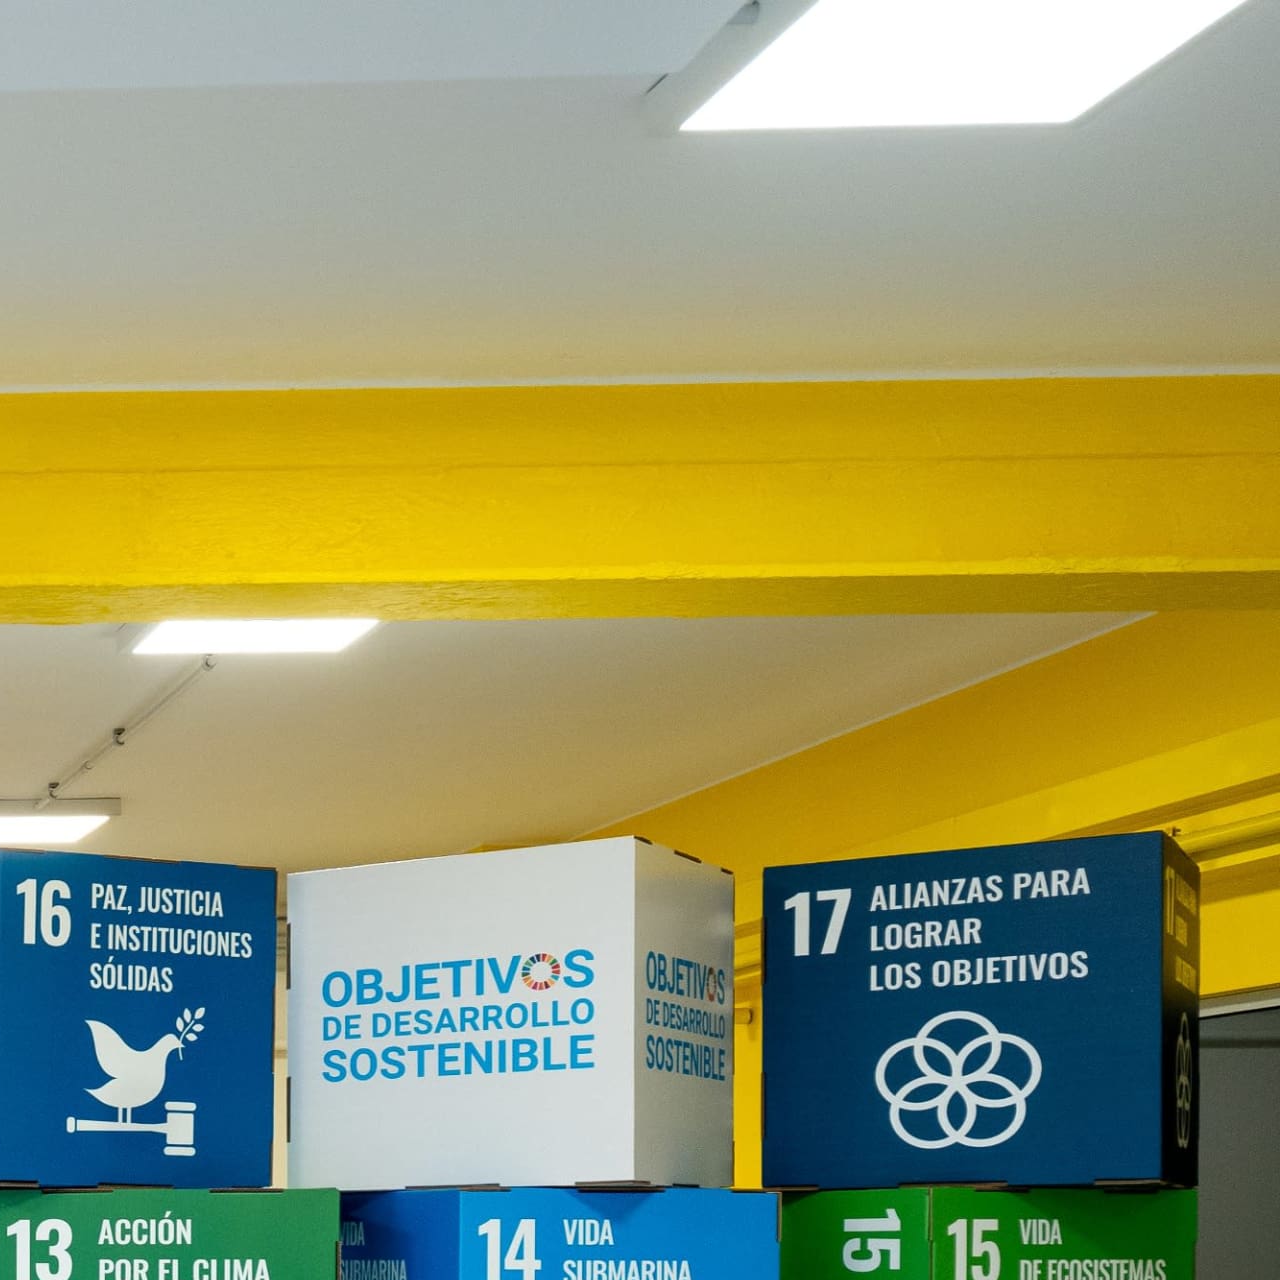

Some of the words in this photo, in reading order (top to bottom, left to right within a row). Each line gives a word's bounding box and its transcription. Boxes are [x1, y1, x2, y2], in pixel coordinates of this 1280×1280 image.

[17, 879, 71, 946] 16
[92, 883, 132, 914] PAZ,
[138, 887, 223, 917] JUSTICIA
[784, 888, 851, 956] 17
[870, 875, 1003, 911] ALIANZAS
[1014, 868, 1090, 899] PARA
[91, 923, 101, 948] E
[108, 924, 252, 958] INSTITUCIONES
[871, 918, 981, 951] LOGRAR
[90, 956, 173, 992] SÓLIDAS
[322, 949, 594, 1008] OBJETIVOS
[646, 951, 726, 1004] OBJETIVOS
[870, 963, 921, 991] LOS
[932, 951, 1088, 987] OBJETIVOS
[323, 1014, 361, 1041] DE
[372, 997, 594, 1037] DESARROLLO
[646, 1002, 660, 1026] DE
[663, 1002, 725, 1041] DESARROLLO
[322, 1034, 594, 1082] SOSTENIBLE
[646, 1035, 726, 1081] SOSTENIBLE
[98, 1211, 191, 1245] ACCIÓN
[563, 1219, 614, 1245] VIDA
[843, 1208, 901, 1272] 15
[1019, 1219, 1062, 1245] VIDA
